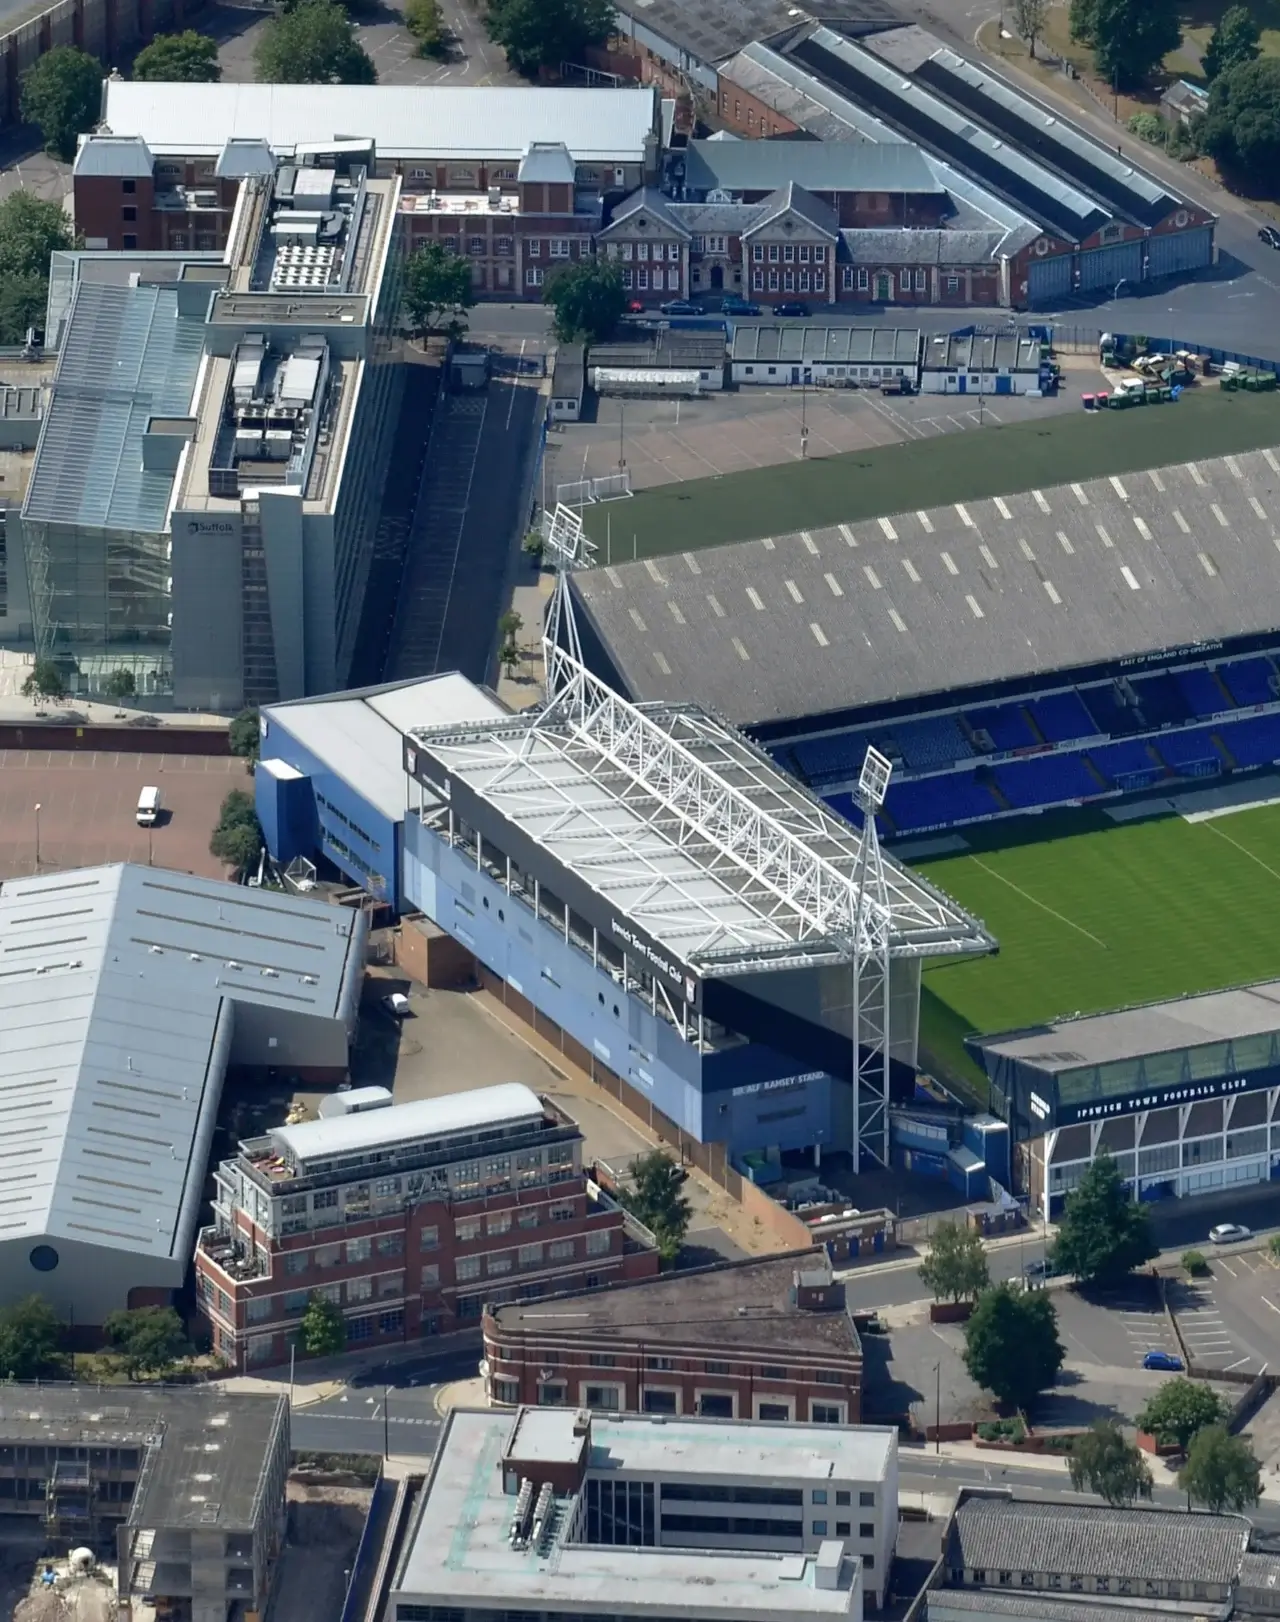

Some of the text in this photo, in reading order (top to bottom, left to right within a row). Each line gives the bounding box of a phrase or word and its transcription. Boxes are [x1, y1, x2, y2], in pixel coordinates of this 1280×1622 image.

[199, 523, 234, 532] Suffolk
[1120, 658, 1135, 667] EAST
[1147, 651, 1177, 662] ENGLAND
[764, 1076, 795, 1090] RAMSEY
[798, 1070, 824, 1084] STAND
[1077, 1078, 1247, 1118] IPSWICH TOWN FOOTBALL CLUB
